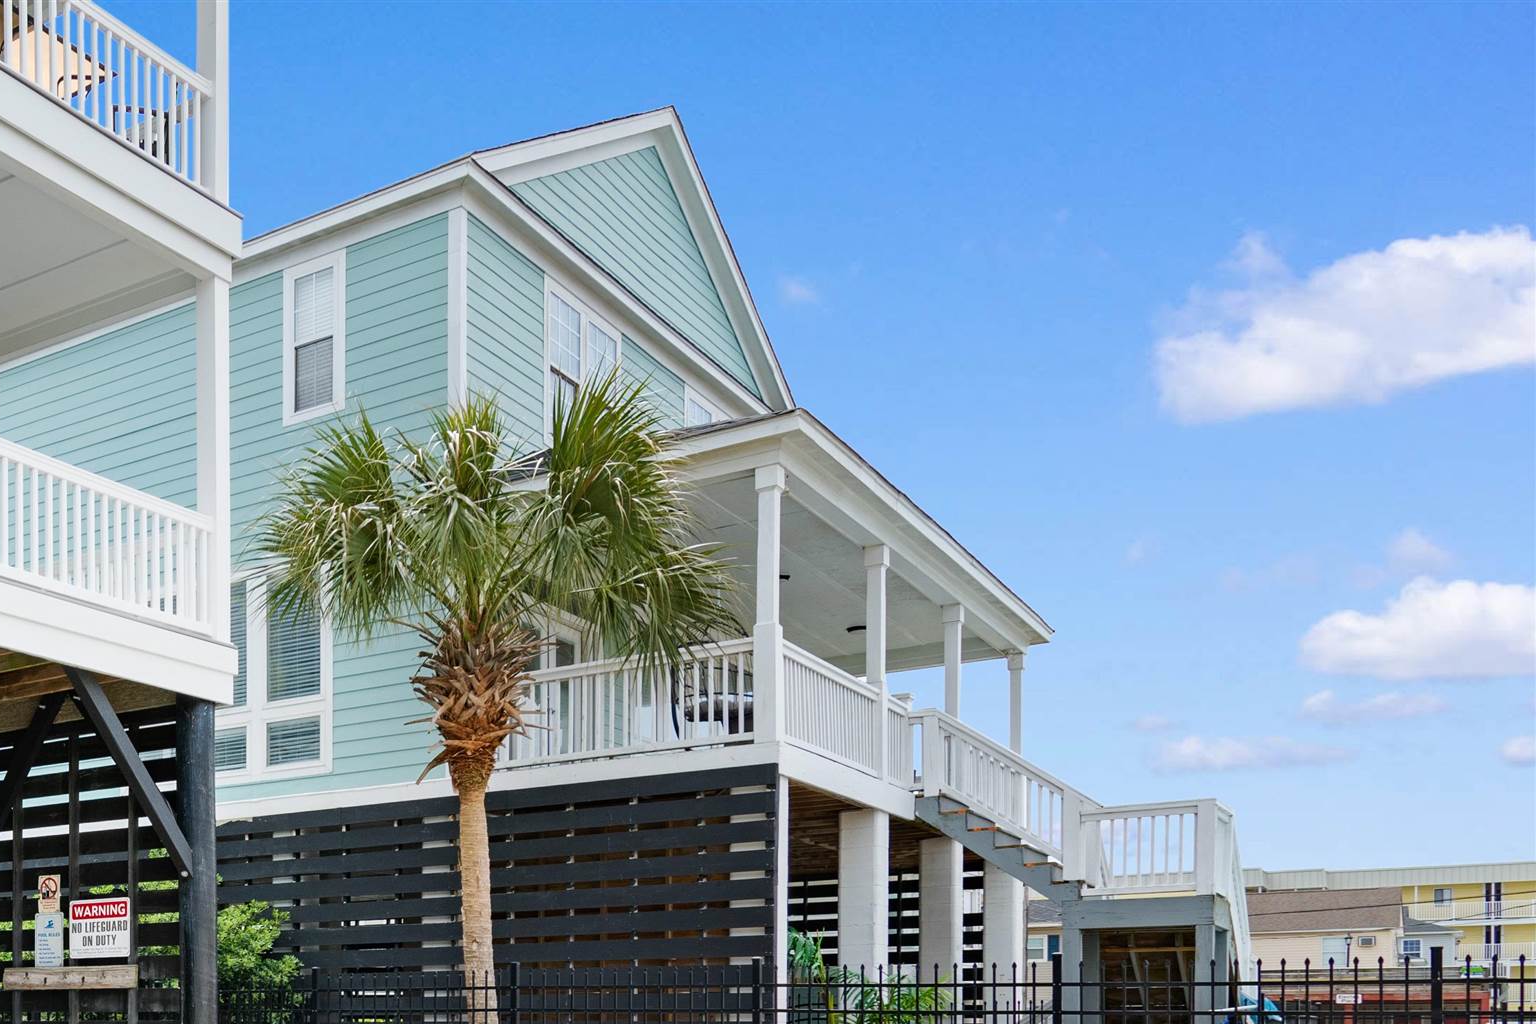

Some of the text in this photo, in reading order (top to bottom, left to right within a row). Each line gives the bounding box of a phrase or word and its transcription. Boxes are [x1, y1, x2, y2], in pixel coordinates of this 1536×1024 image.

[73, 903, 126, 918] WARNING
[71, 920, 128, 933] NO LIFEGUARD
[82, 934, 117, 947] ON DUTY
